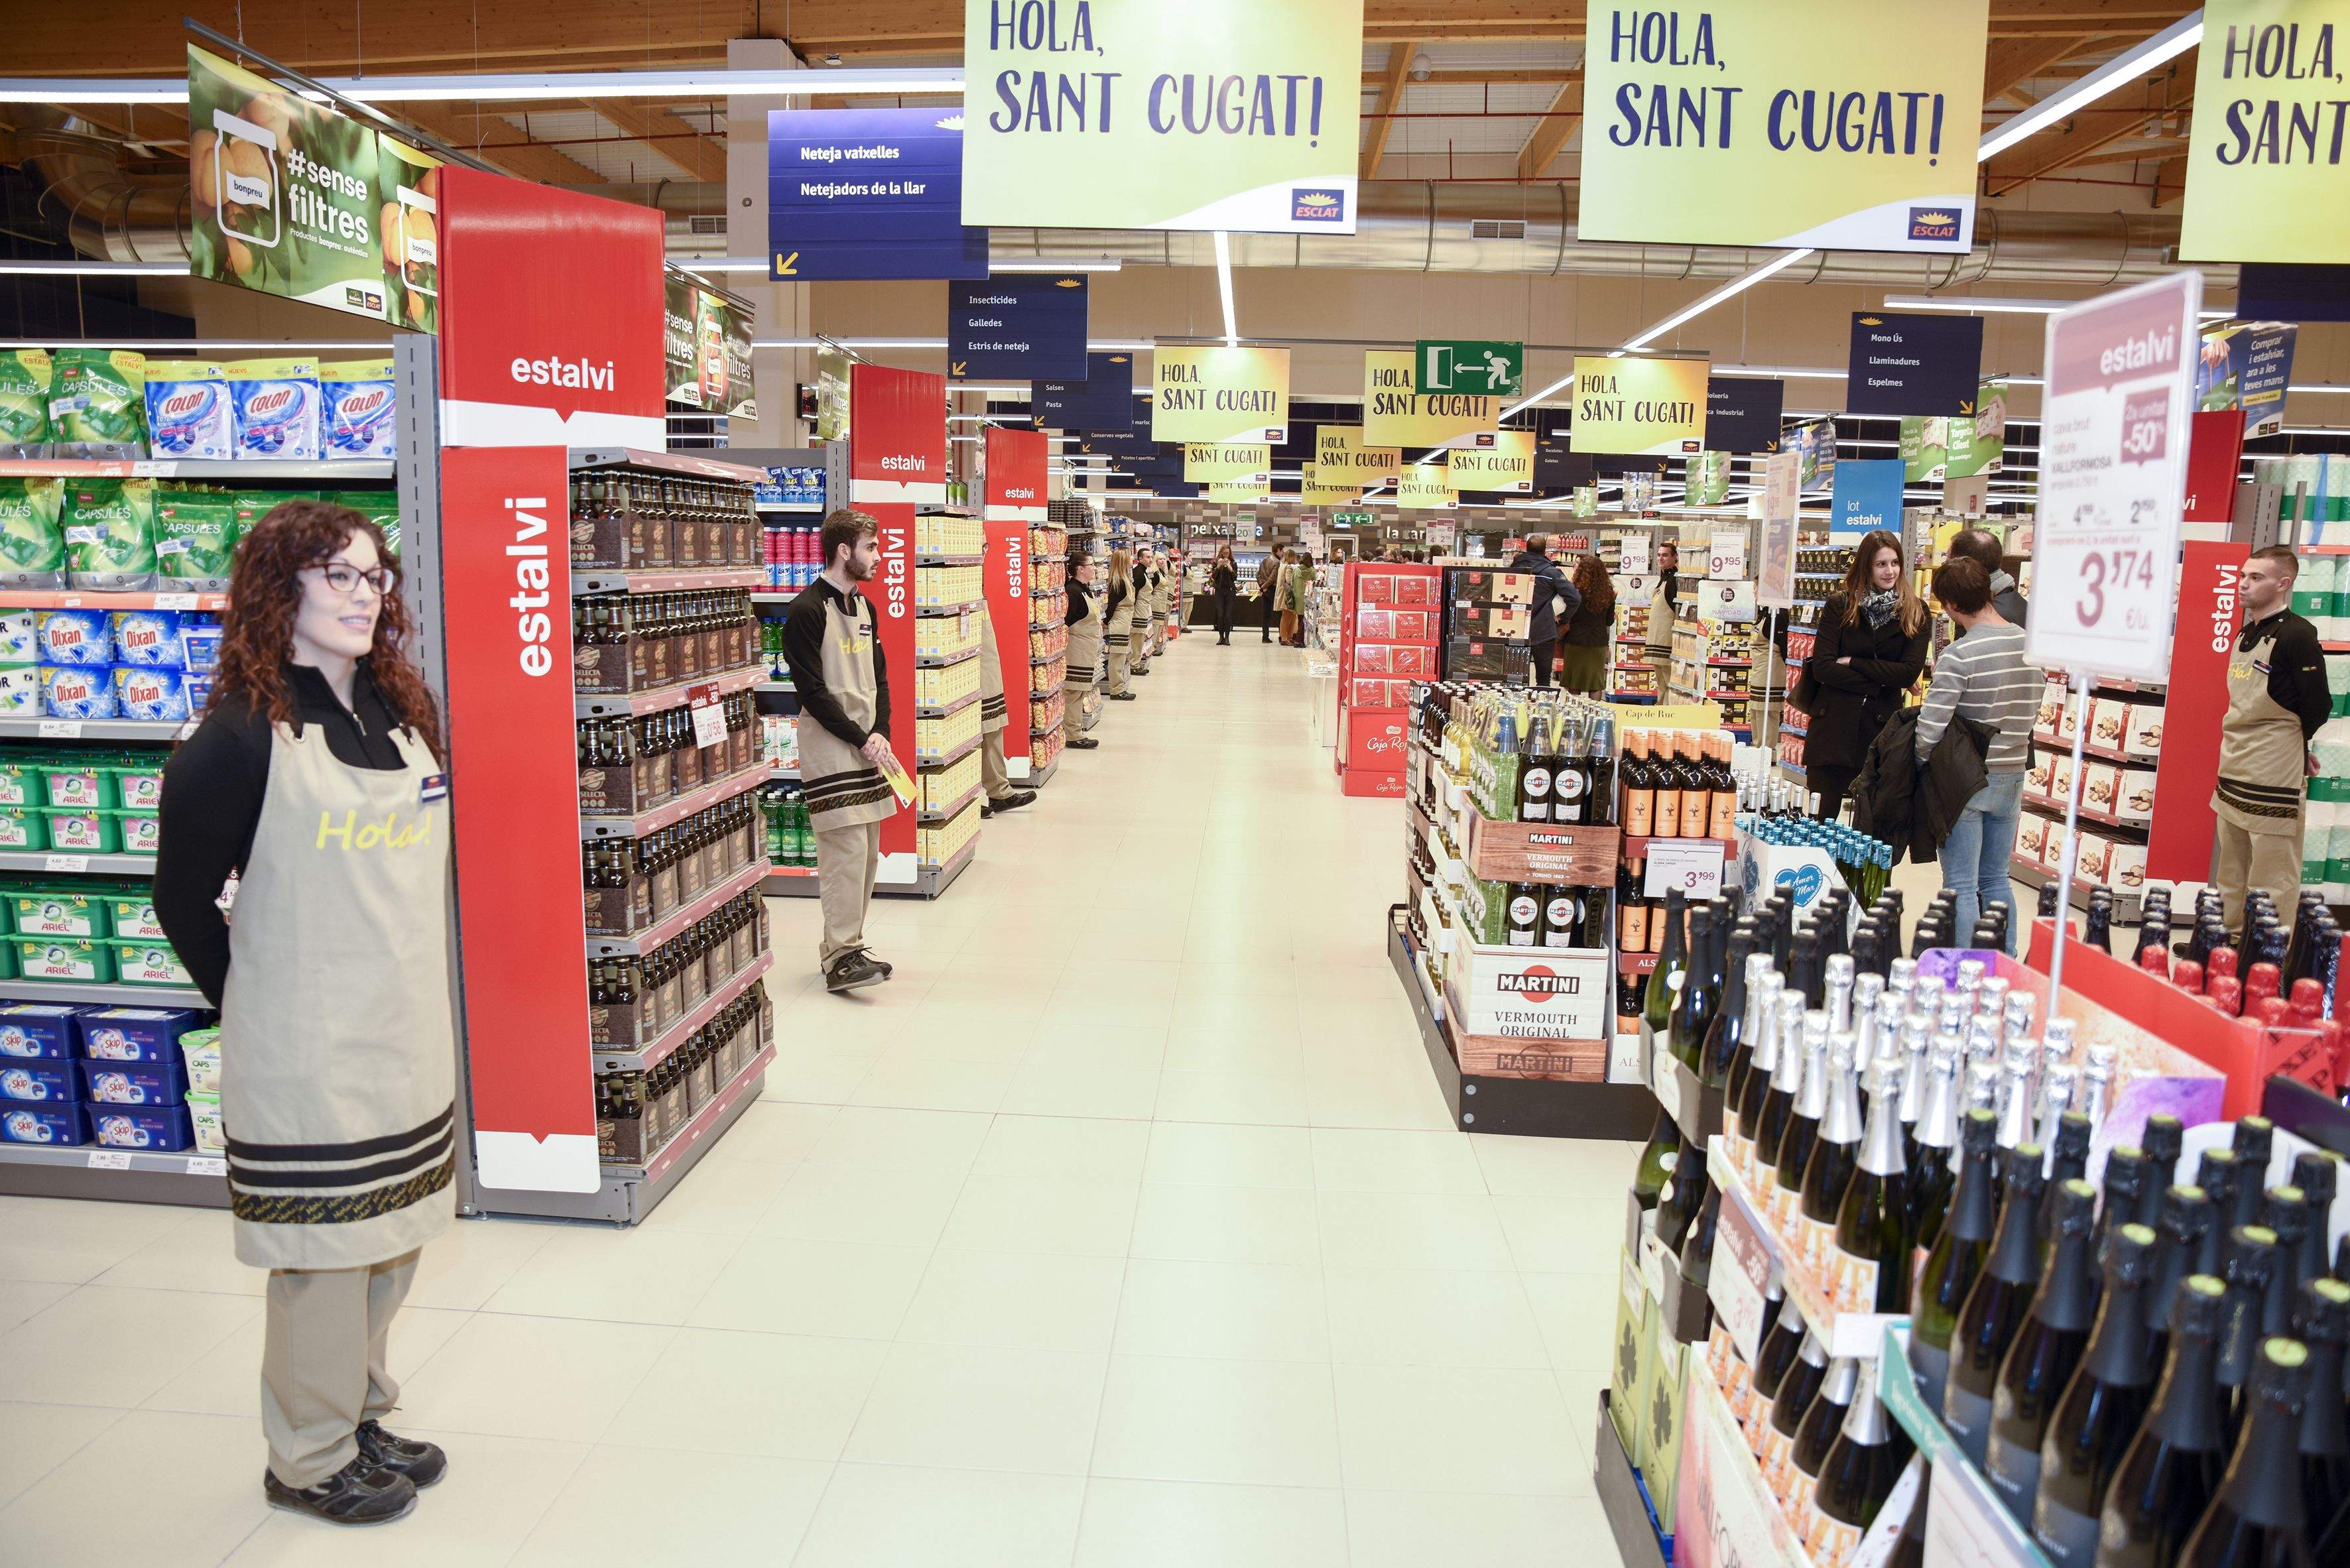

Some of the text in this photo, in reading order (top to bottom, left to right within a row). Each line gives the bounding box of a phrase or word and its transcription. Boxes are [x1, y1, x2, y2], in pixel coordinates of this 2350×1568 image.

[990, 0, 1104, 56] HOLA,
[1611, 11, 1725, 71] HOLA,
[2223, 23, 2343, 83] HOLA,
[989, 70, 1322, 148] SANT CUGAT!
[1609, 82, 1944, 167] SANT CUGAT!
[800, 145, 899, 162] Neteja vaixelles
[287, 149, 367, 201] #sense
[234, 180, 263, 198] bonpreu
[800, 181, 925, 199] Netejadors de la llar
[289, 184, 369, 244] filtres
[1296, 206, 1339, 218] ESCLAT
[290, 228, 318, 243] Productes
[1913, 225, 1955, 238] ESCLAT
[412, 243, 432, 256] bonpreu
[969, 294, 1017, 306] Insecticides
[969, 318, 1002, 328] Galledes
[727, 333, 749, 355] #sense
[1871, 333, 1902, 342] Mono Ús
[2251, 335, 2282, 351] Comprar
[968, 341, 1029, 353] Estris de neteja
[2100, 325, 2175, 375] estalvi
[1869, 357, 1920, 366] Llaminadures
[2253, 349, 2284, 363] estalviar,
[511, 356, 614, 391] estalvi
[727, 353, 750, 379] filtres
[1162, 364, 1201, 384] HOLA,
[2247, 369, 2258, 377] ara
[2266, 363, 2276, 373] les
[1373, 369, 1413, 389] HOLA,
[1581, 375, 1621, 395] HOLA,
[1868, 378, 1902, 387] Espelmes
[2245, 376, 2284, 391] teves mans
[62, 381, 127, 396] CAPSULES
[165, 391, 204, 415] COLON
[250, 390, 291, 414] COLON
[341, 391, 384, 413] COLON
[1161, 388, 1276, 416] SANT CUGAT!
[1373, 393, 1487, 421] SANT CUGAT!
[1581, 399, 1694, 427] SANT CUGAT!
[1322, 437, 1347, 450] HOLA,
[881, 455, 925, 471] estalvi
[1190, 448, 1263, 465] SANT CUGAT!
[1322, 452, 1393, 469] SANT CUGAT!
[1453, 456, 1526, 475] SANT CUGAT!
[1005, 487, 1034, 499] estalvi
[1401, 484, 1421, 496] SANT
[75, 506, 131, 520] CAPSULES
[1847, 501, 1859, 511] lot
[1847, 513, 1882, 525] estalvi
[162, 523, 221, 534] CAPSULES
[1387, 526, 1398, 539] la
[1005, 536, 1022, 597] estalvi
[1622, 556, 1646, 570] 9'95
[1711, 556, 1741, 573] 9'95
[883, 528, 905, 618] estalvi
[505, 497, 552, 677] estalvi
[2076, 550, 2154, 629] 3'74
[2211, 564, 2239, 653] estalvi
[52, 629, 82, 647] Dixan
[127, 629, 156, 647] Dixan
[56, 684, 86, 703] Dixan
[130, 684, 159, 703] Dixan
[1626, 709, 1642, 719] Cap
[1658, 709, 1675, 718] Ruc
[1367, 737, 1388, 753] Caja
[1377, 782, 1404, 792] Caja Roja
[63, 796, 89, 804] ARIEL
[316, 809, 431, 851] Hola!
[66, 837, 91, 846] ARIEL
[1529, 833, 1573, 845] MARTINI
[1527, 853, 1572, 863] VERMOUTH
[1530, 861, 1568, 870] ORIGINAL
[1684, 871, 1715, 888] 3'99
[1792, 874, 1814, 886] Amor
[1795, 884, 1816, 896] Mar
[42, 923, 70, 932] ARIEL
[45, 966, 74, 975] ARIEL
[143, 971, 172, 979] ARIEL
[1498, 974, 1579, 995] MARTINI
[1495, 1011, 1577, 1026] VERMOUTH
[1500, 1025, 1569, 1038] ORIGINAL
[192, 1059, 210, 1068] CAPS
[1497, 1054, 1572, 1073] MARTINI
